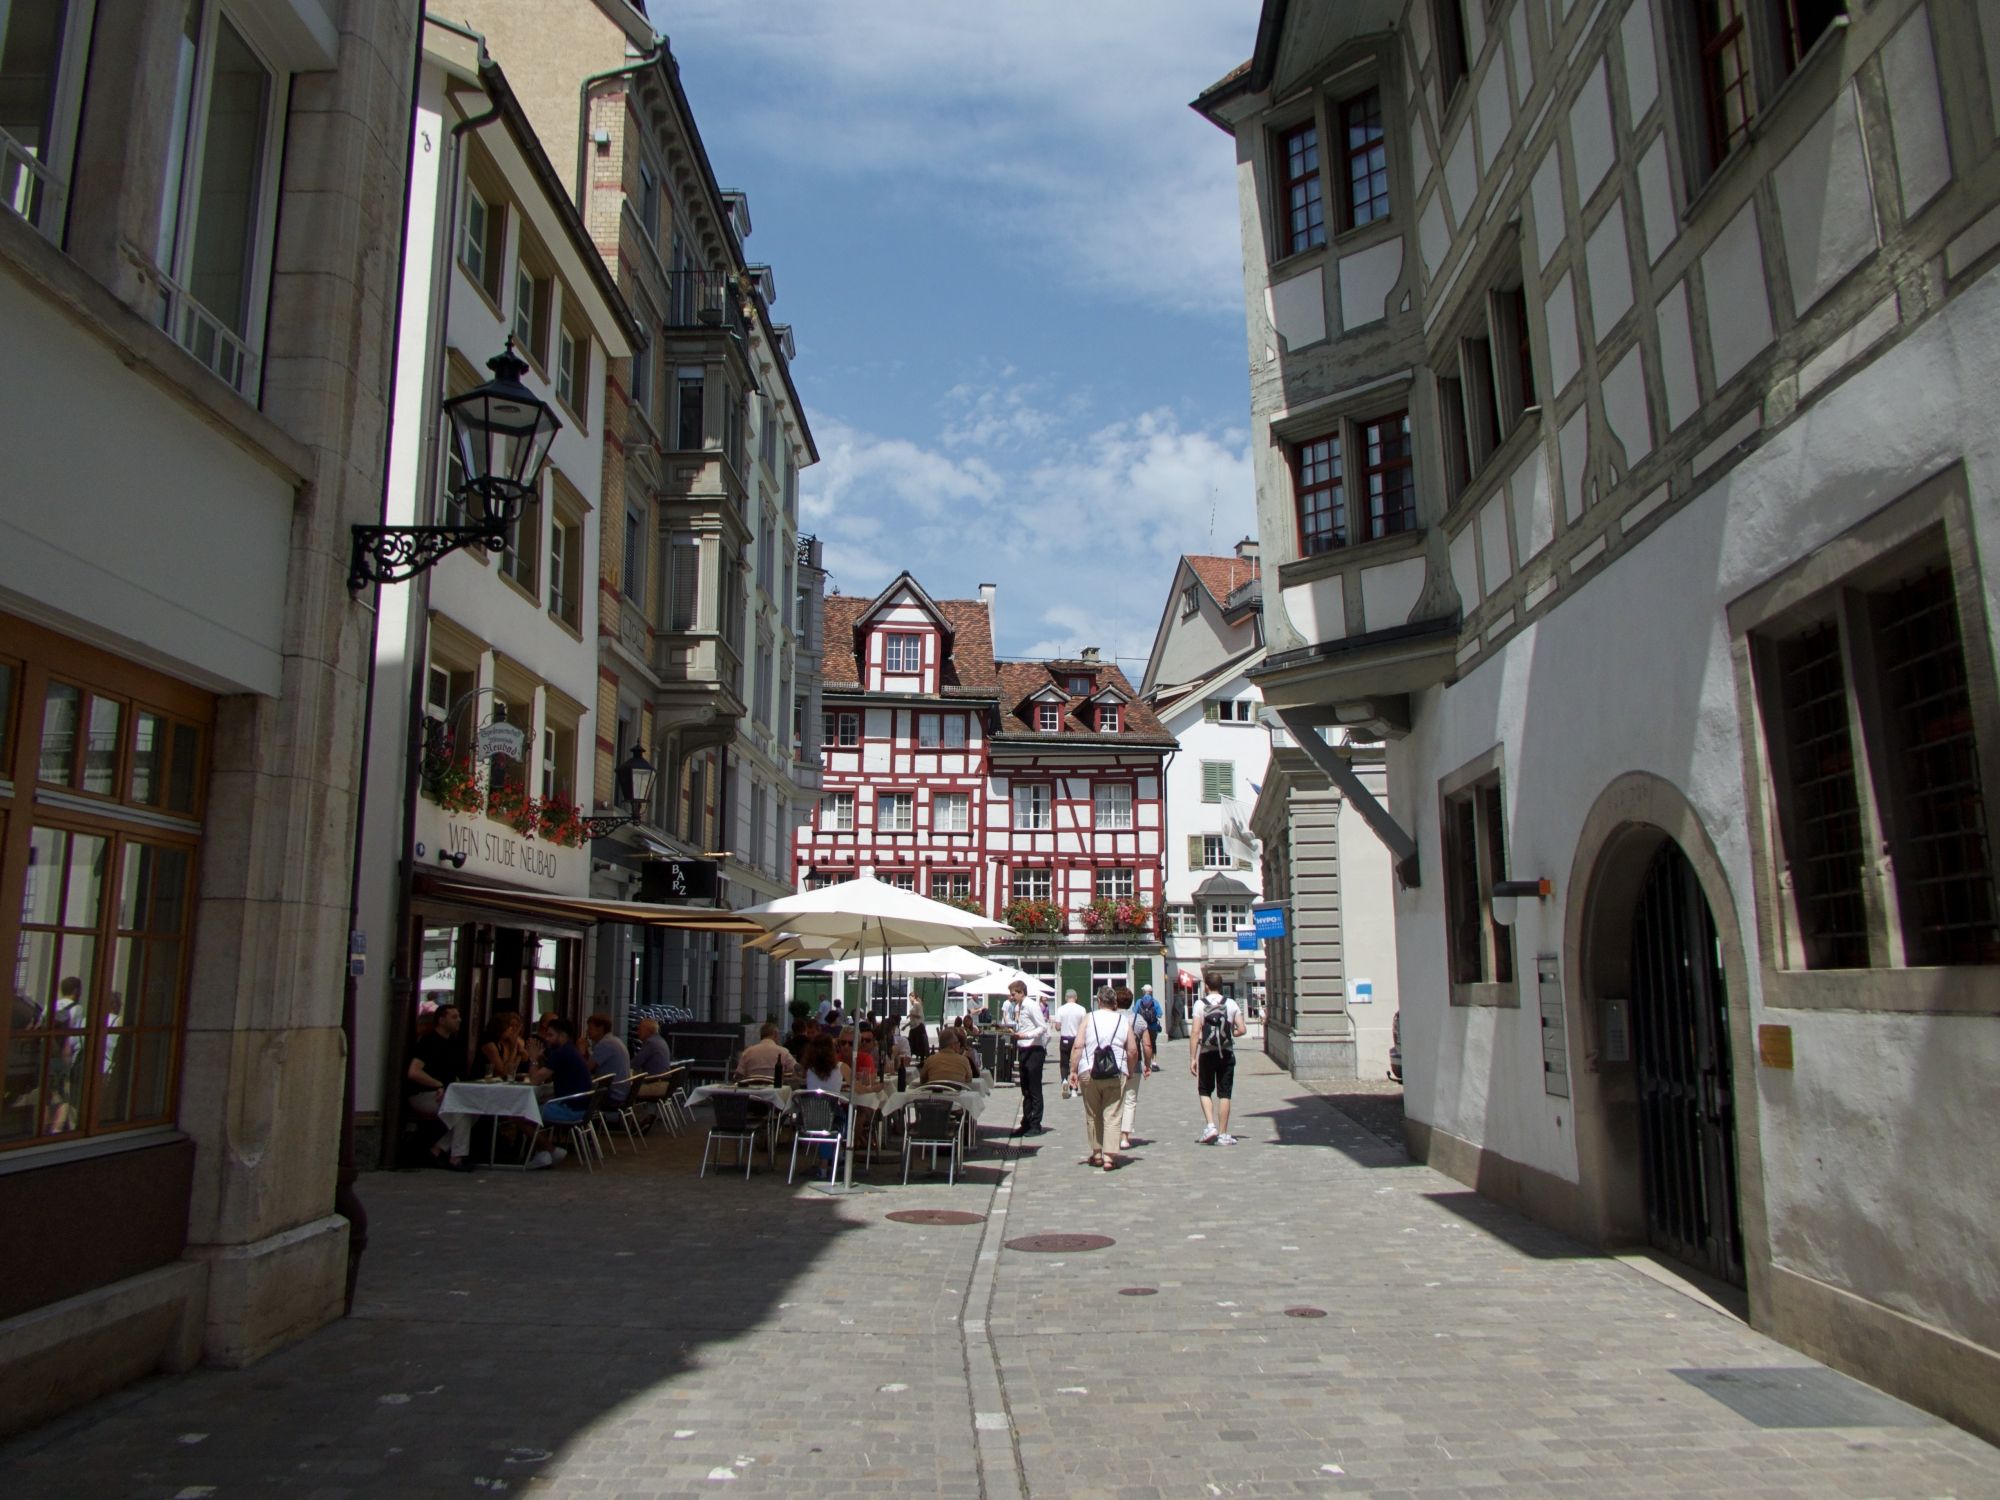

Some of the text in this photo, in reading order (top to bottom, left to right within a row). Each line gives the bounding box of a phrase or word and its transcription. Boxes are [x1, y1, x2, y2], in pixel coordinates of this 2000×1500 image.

[449, 822, 479, 857] WEIN
[484, 832, 516, 867] STUBE
[520, 843, 557, 879] NEUBAD
[1256, 916, 1277, 924] HYPO
